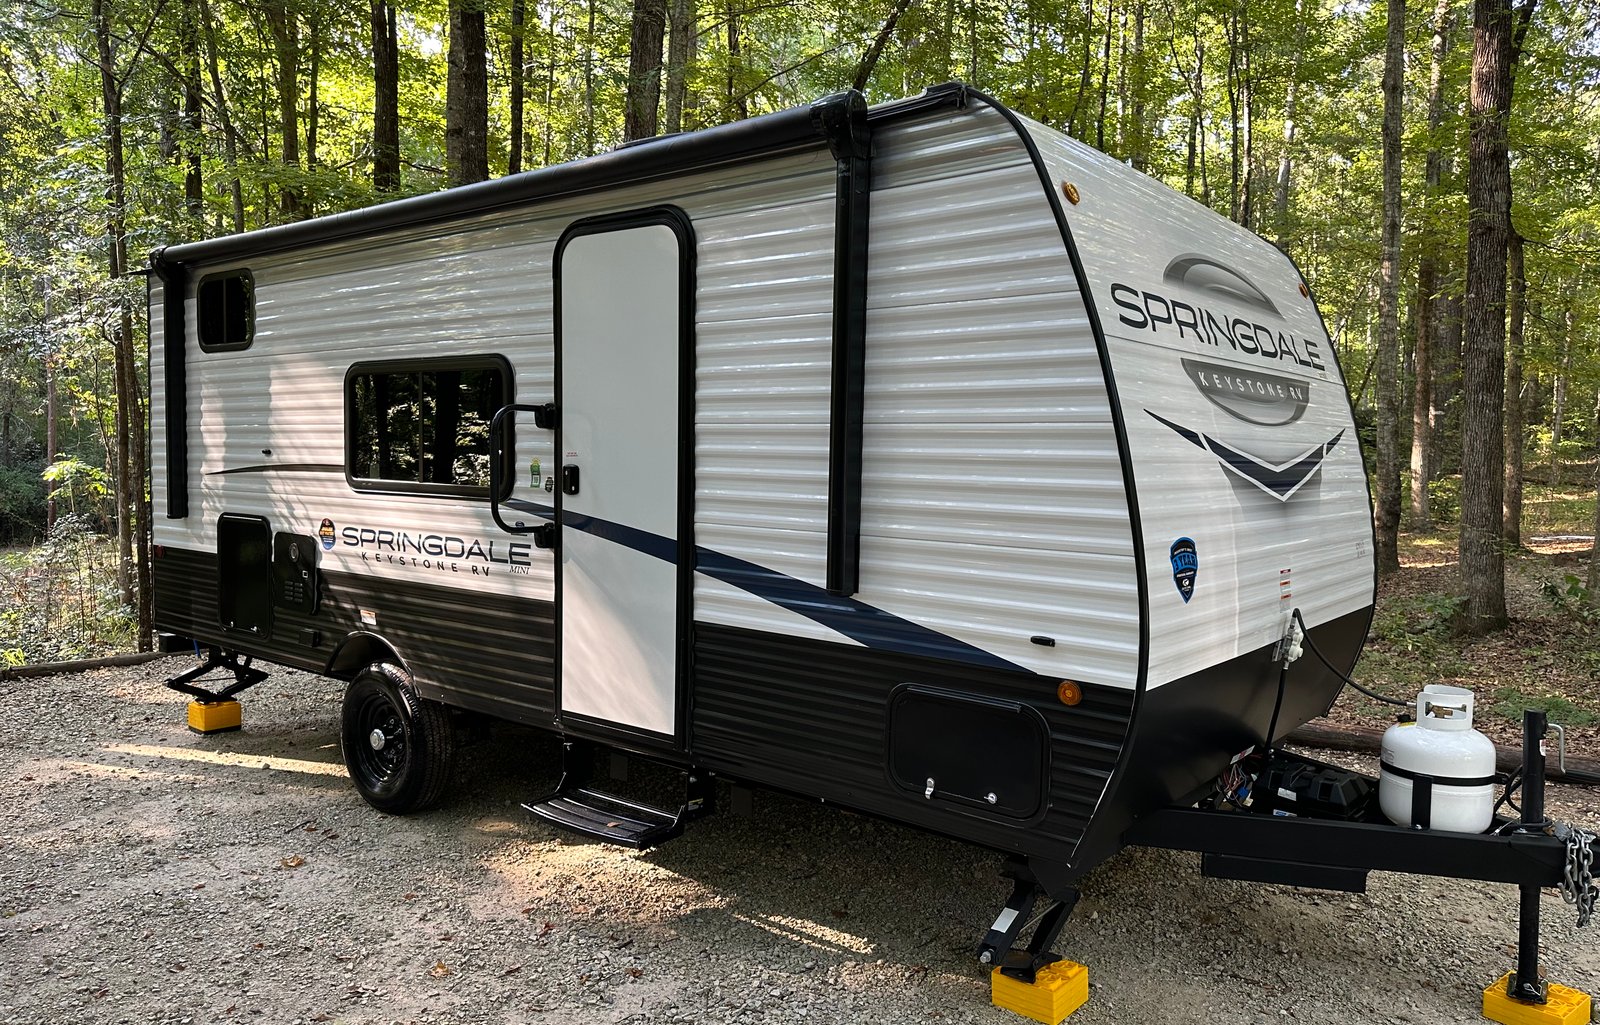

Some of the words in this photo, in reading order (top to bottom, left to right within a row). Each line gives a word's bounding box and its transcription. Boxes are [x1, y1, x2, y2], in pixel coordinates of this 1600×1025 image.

[1111, 283, 1325, 371] SPRINGDALE
[1198, 371, 1284, 397] KEYSTONE
[1290, 387, 1303, 400] RV
[343, 526, 531, 566] SPRINGDALE
[362, 551, 458, 573] KEYSTONE
[472, 565, 489, 577] RV
[509, 565, 530, 575] MINI
